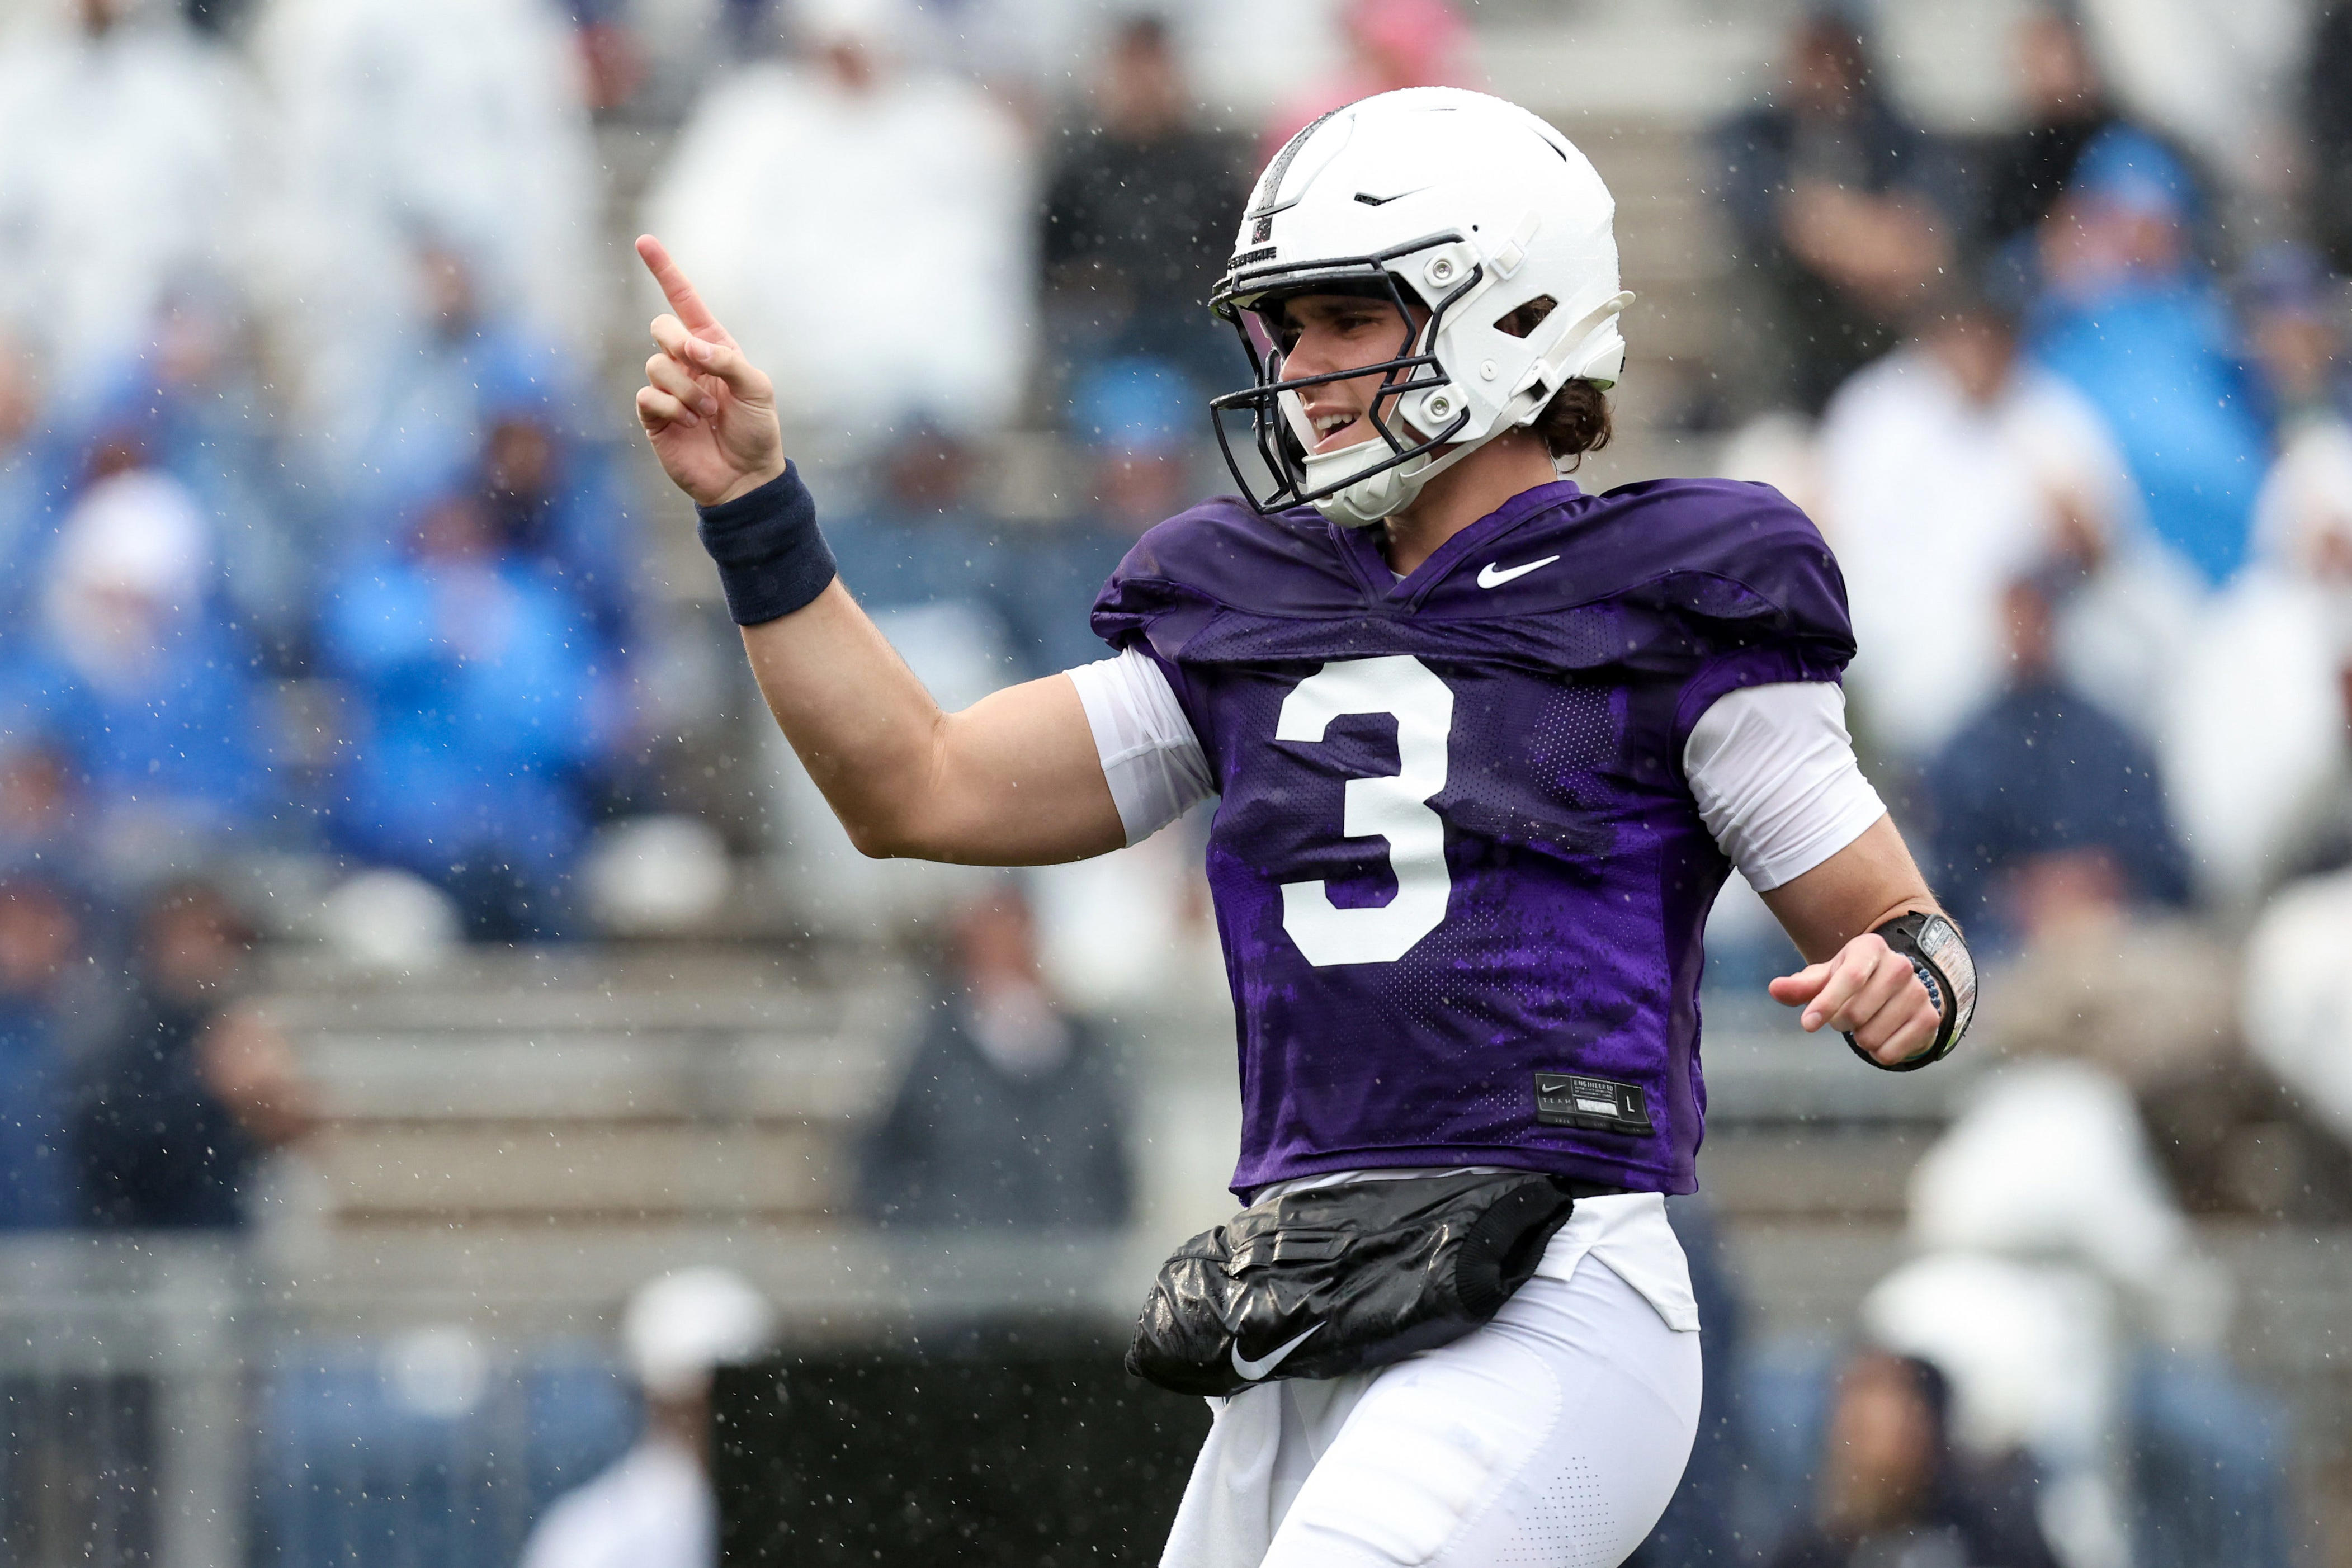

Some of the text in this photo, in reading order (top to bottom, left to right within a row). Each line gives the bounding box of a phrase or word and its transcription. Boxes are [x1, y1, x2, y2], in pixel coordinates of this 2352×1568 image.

[1275, 654, 1454, 967] 3
[1574, 1080, 1614, 1092] ENGINEERED
[1626, 1095, 1635, 1113] L
